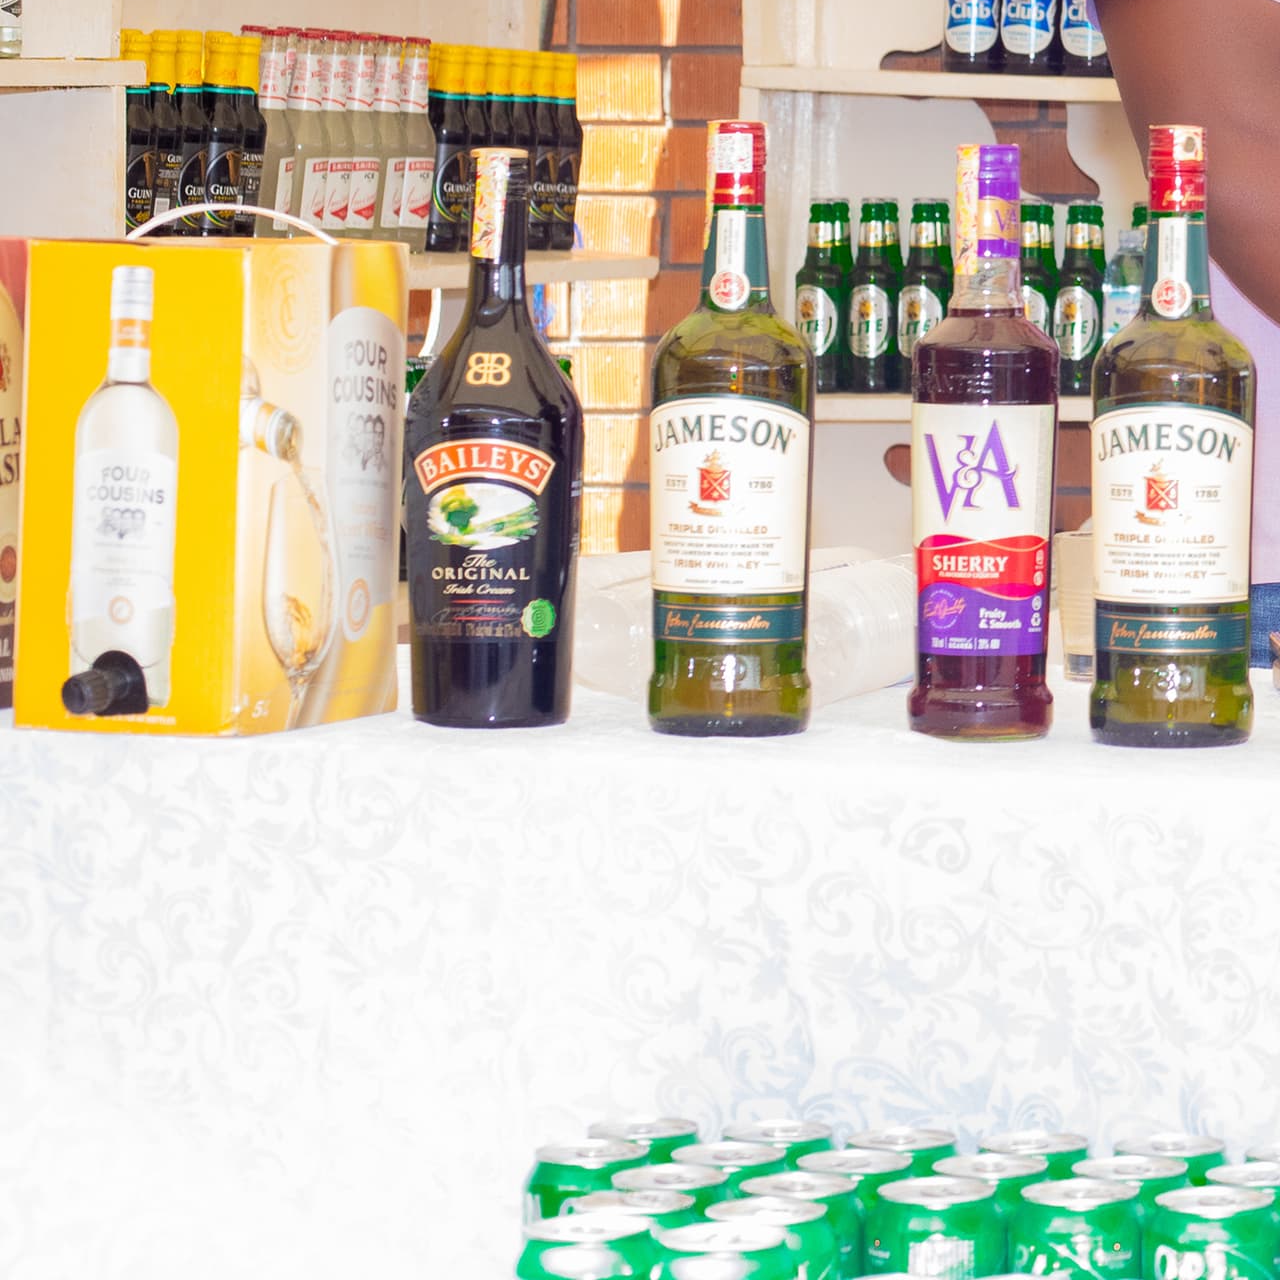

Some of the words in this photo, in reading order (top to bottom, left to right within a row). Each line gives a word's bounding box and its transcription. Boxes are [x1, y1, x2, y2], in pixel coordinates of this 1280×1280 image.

[850, 318, 885, 337] LITE
[899, 317, 931, 336] LITE
[1055, 319, 1090, 338] LITE
[344, 339, 387, 373] FOUR
[332, 376, 397, 410] COUSINS
[655, 414, 792, 454] JAMESON
[1098, 423, 1236, 463] JAMESON
[421, 446, 543, 481] BAILEYS
[102, 465, 150, 484] FOUR
[86, 484, 165, 505] COUSINS
[668, 523, 704, 534] TRIPLE
[1113, 533, 1149, 544] TRIPLE
[462, 553, 497, 568] The
[674, 558, 702, 568] IRISH
[932, 554, 1009, 572] SHERRY
[431, 567, 530, 581] ORIGINAL
[1121, 569, 1149, 579] IRISH
[443, 583, 473, 595] Irish
[476, 583, 515, 595] Cream
[979, 607, 1007, 621] Fruity
[989, 618, 1022, 630] Smooth
